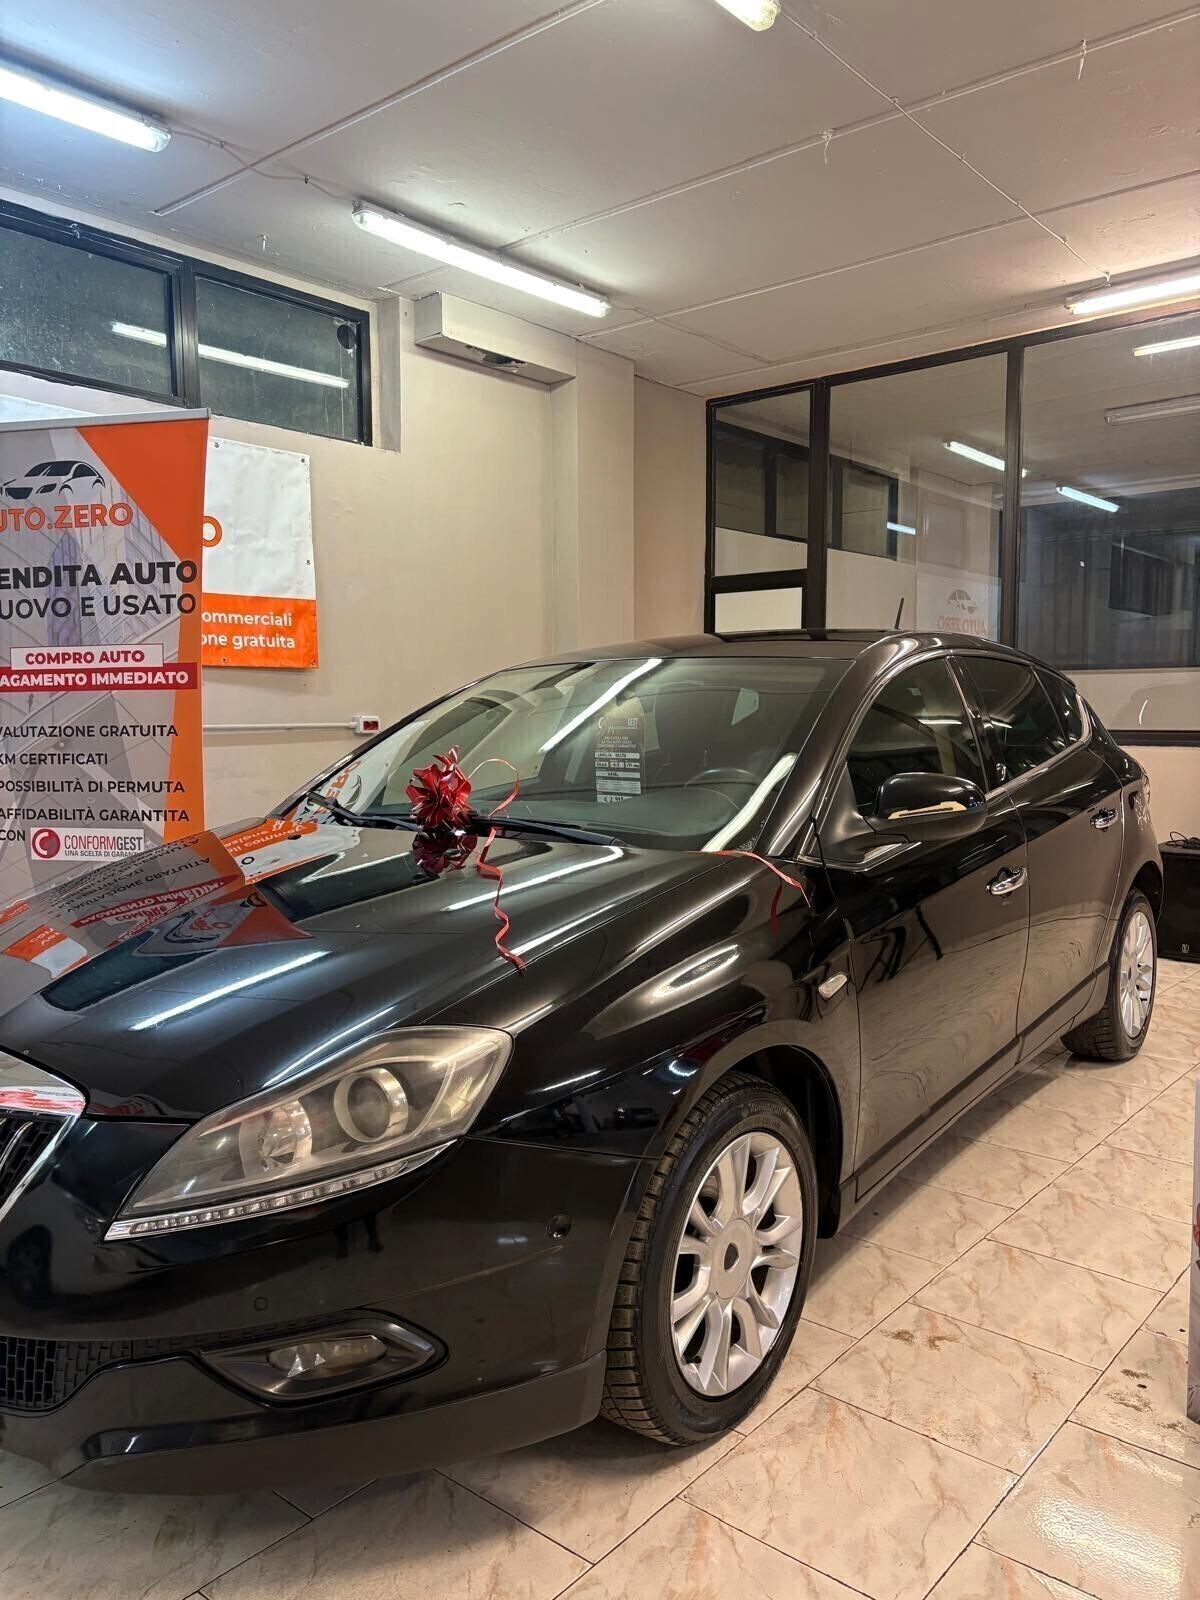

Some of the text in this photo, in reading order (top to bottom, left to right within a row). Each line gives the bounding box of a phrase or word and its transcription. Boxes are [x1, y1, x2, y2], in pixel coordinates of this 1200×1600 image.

[0, 560, 198, 590] ENDITA AUTO
[0, 593, 196, 620] UOVO E USATO
[201, 611, 292, 626] ommerciali
[232, 633, 295, 650] gratuita
[25, 650, 145, 665] COMPRO AUTO
[0, 670, 189, 687] AGAMENTO IMMEDIATO
[99, 724, 179, 737] GRATUITA
[20, 753, 108, 765] CERTIFICATI
[88, 781, 103, 793] DI
[108, 781, 185, 793] PERMUTA
[0, 806, 190, 822] AFFIDABILITÀ GARANTITA
[0, 829, 26, 841] CON
[64, 835, 143, 851] CONFORMGEST
